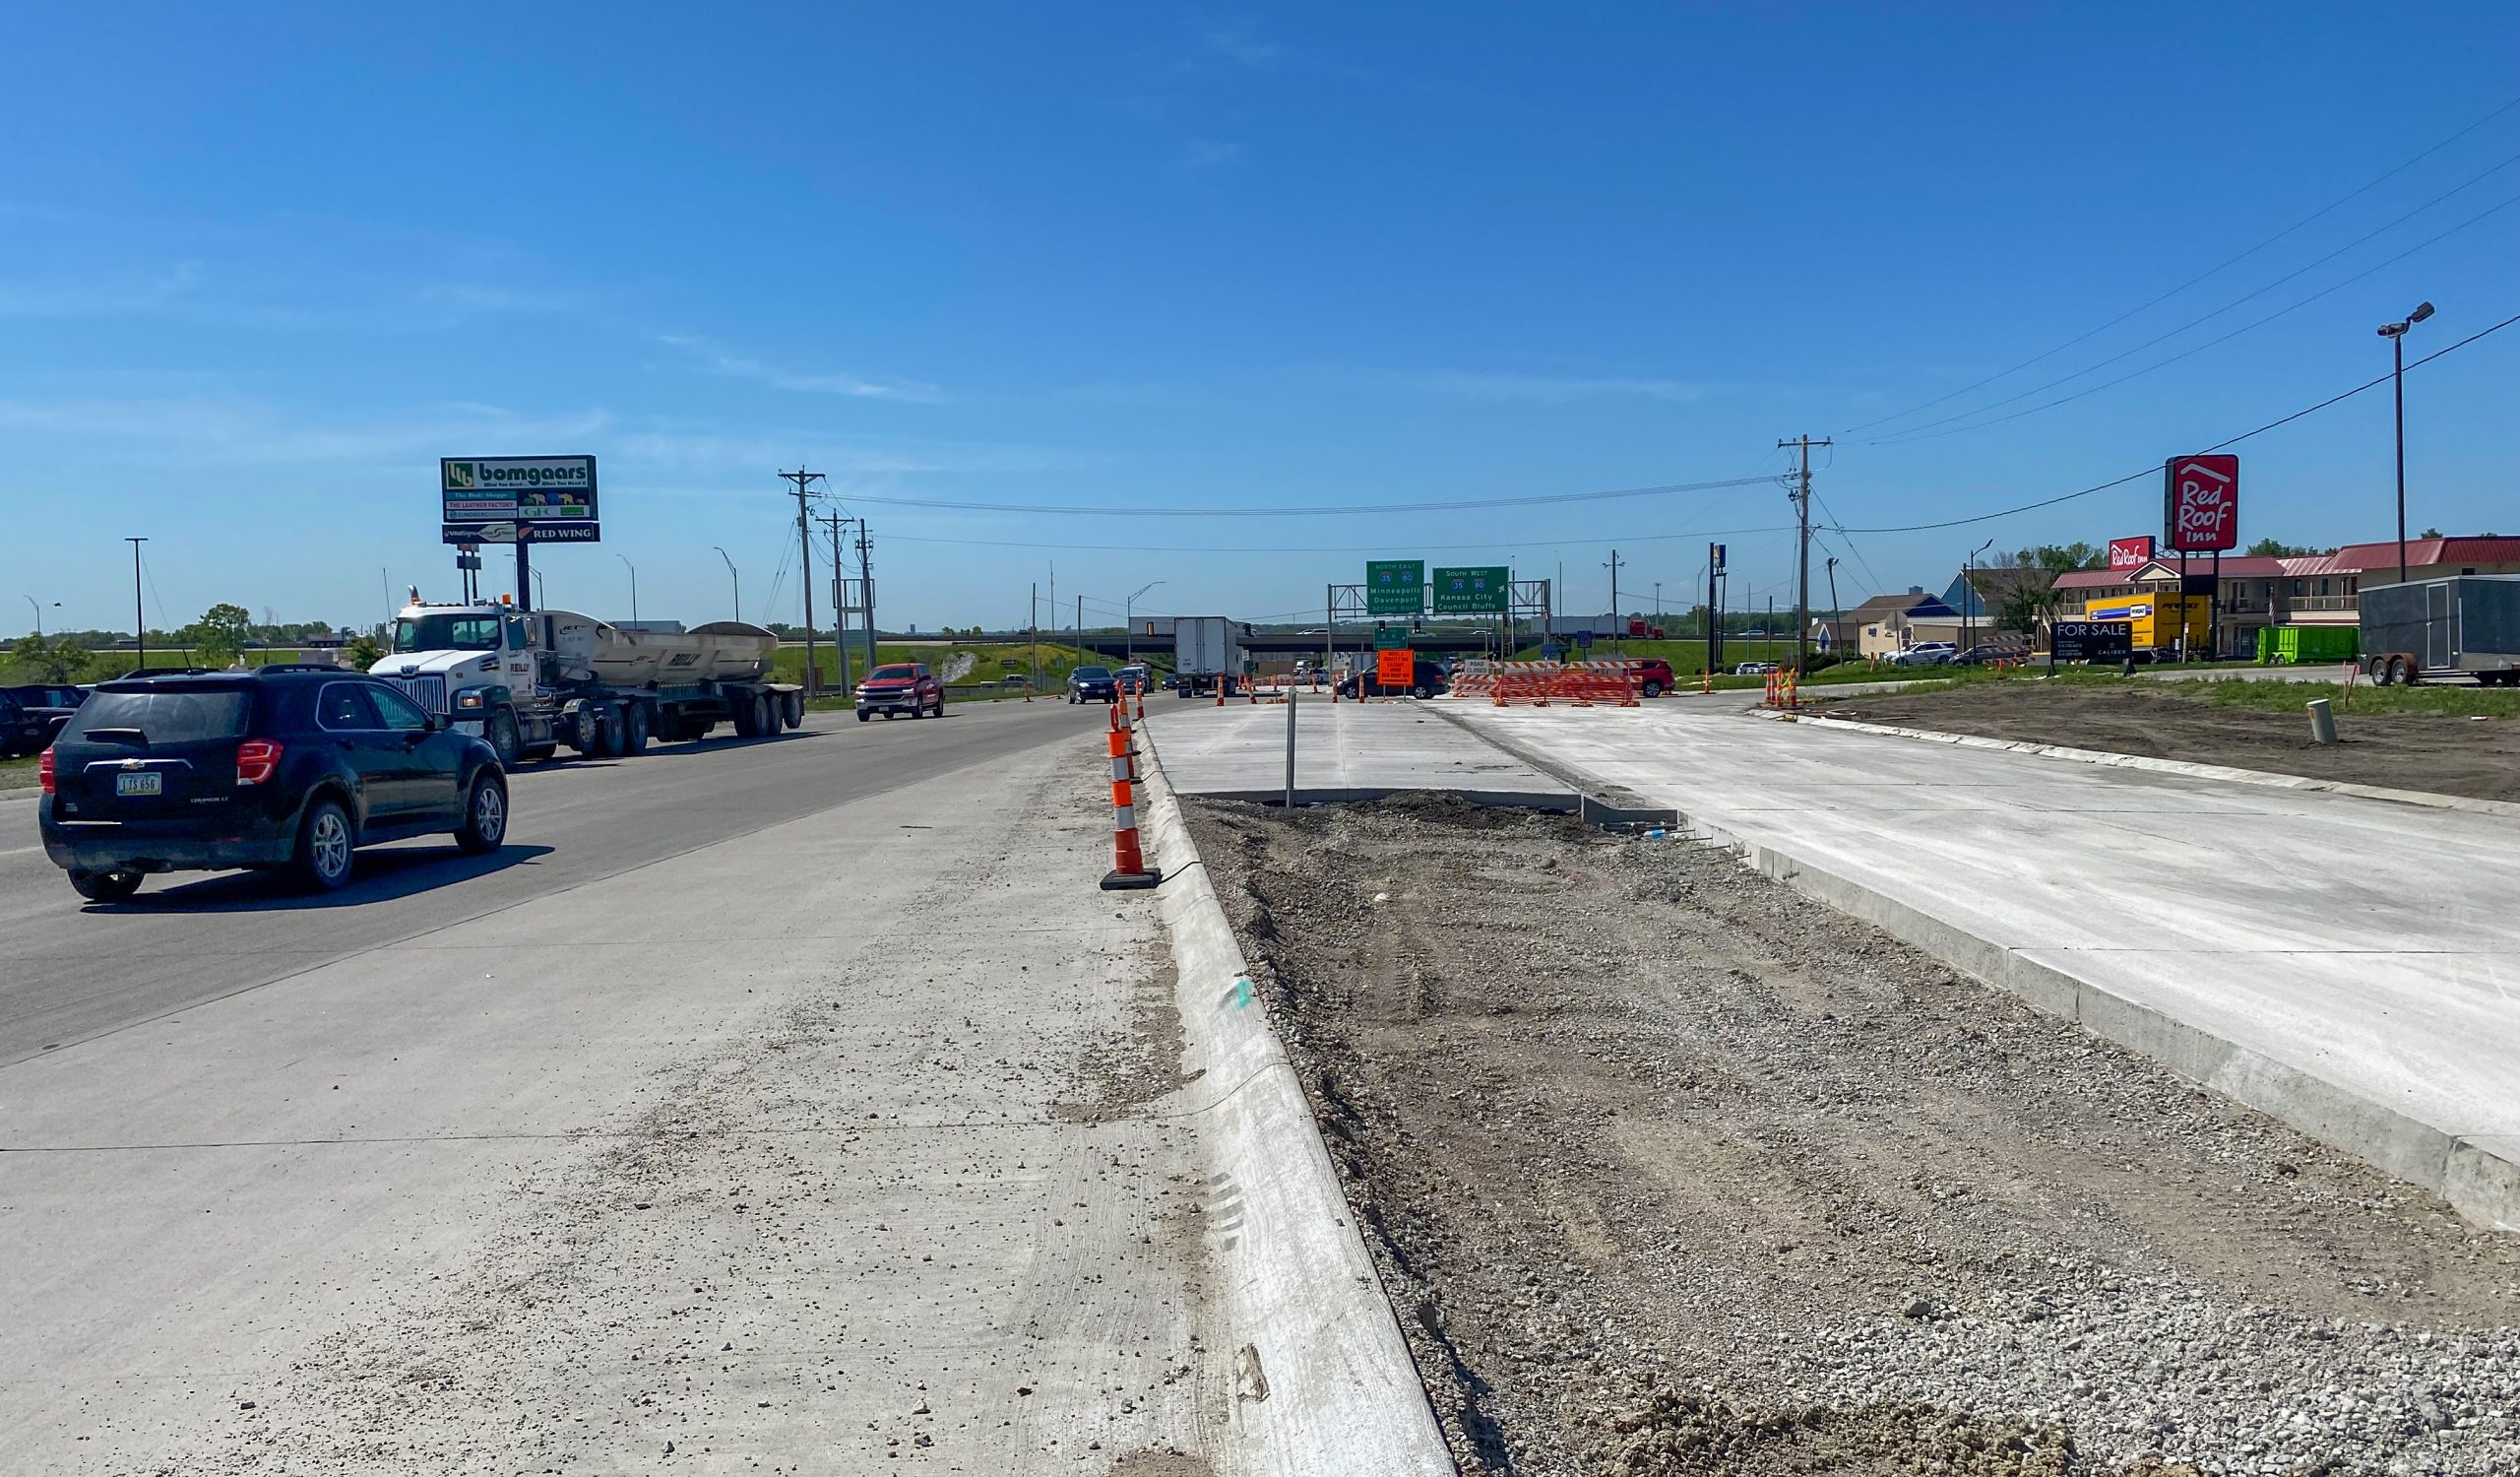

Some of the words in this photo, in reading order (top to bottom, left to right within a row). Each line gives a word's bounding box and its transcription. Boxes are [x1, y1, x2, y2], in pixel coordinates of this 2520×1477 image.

[479, 463, 586, 485] bomgaars
[2182, 481, 2223, 506] Red
[2178, 501, 2232, 532] Roof
[534, 530, 556, 539] RED
[556, 529, 591, 538] WING
[2112, 549, 2124, 566] Red
[2123, 545, 2140, 566] Roof
[2057, 624, 2087, 636] FOR
[2091, 623, 2126, 636] SALE
[510, 663, 530, 673] REILLY
[668, 654, 703, 666] REILLY
